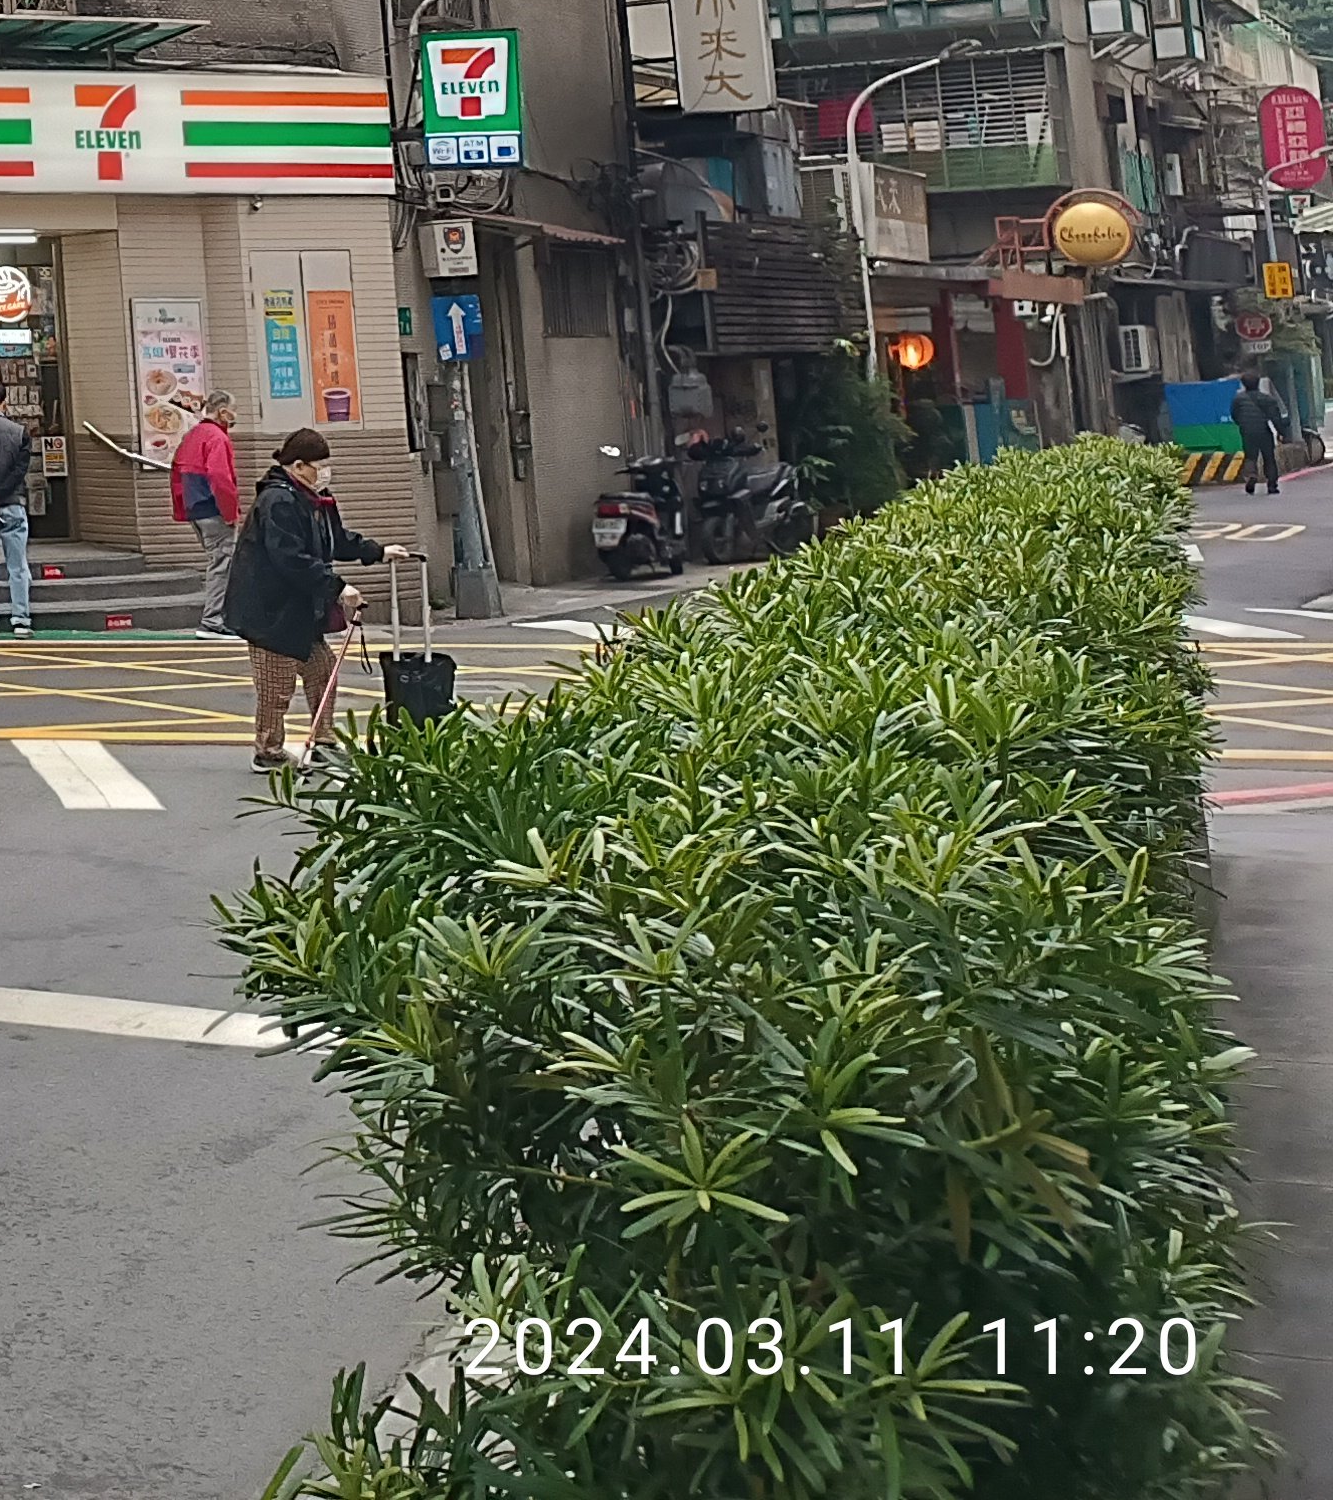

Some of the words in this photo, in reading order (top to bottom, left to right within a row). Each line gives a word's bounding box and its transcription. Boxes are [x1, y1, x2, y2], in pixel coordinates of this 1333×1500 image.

[440, 46, 496, 118] 7
[74, 83, 137, 181] 7
[463, 140, 484, 148] ATM
